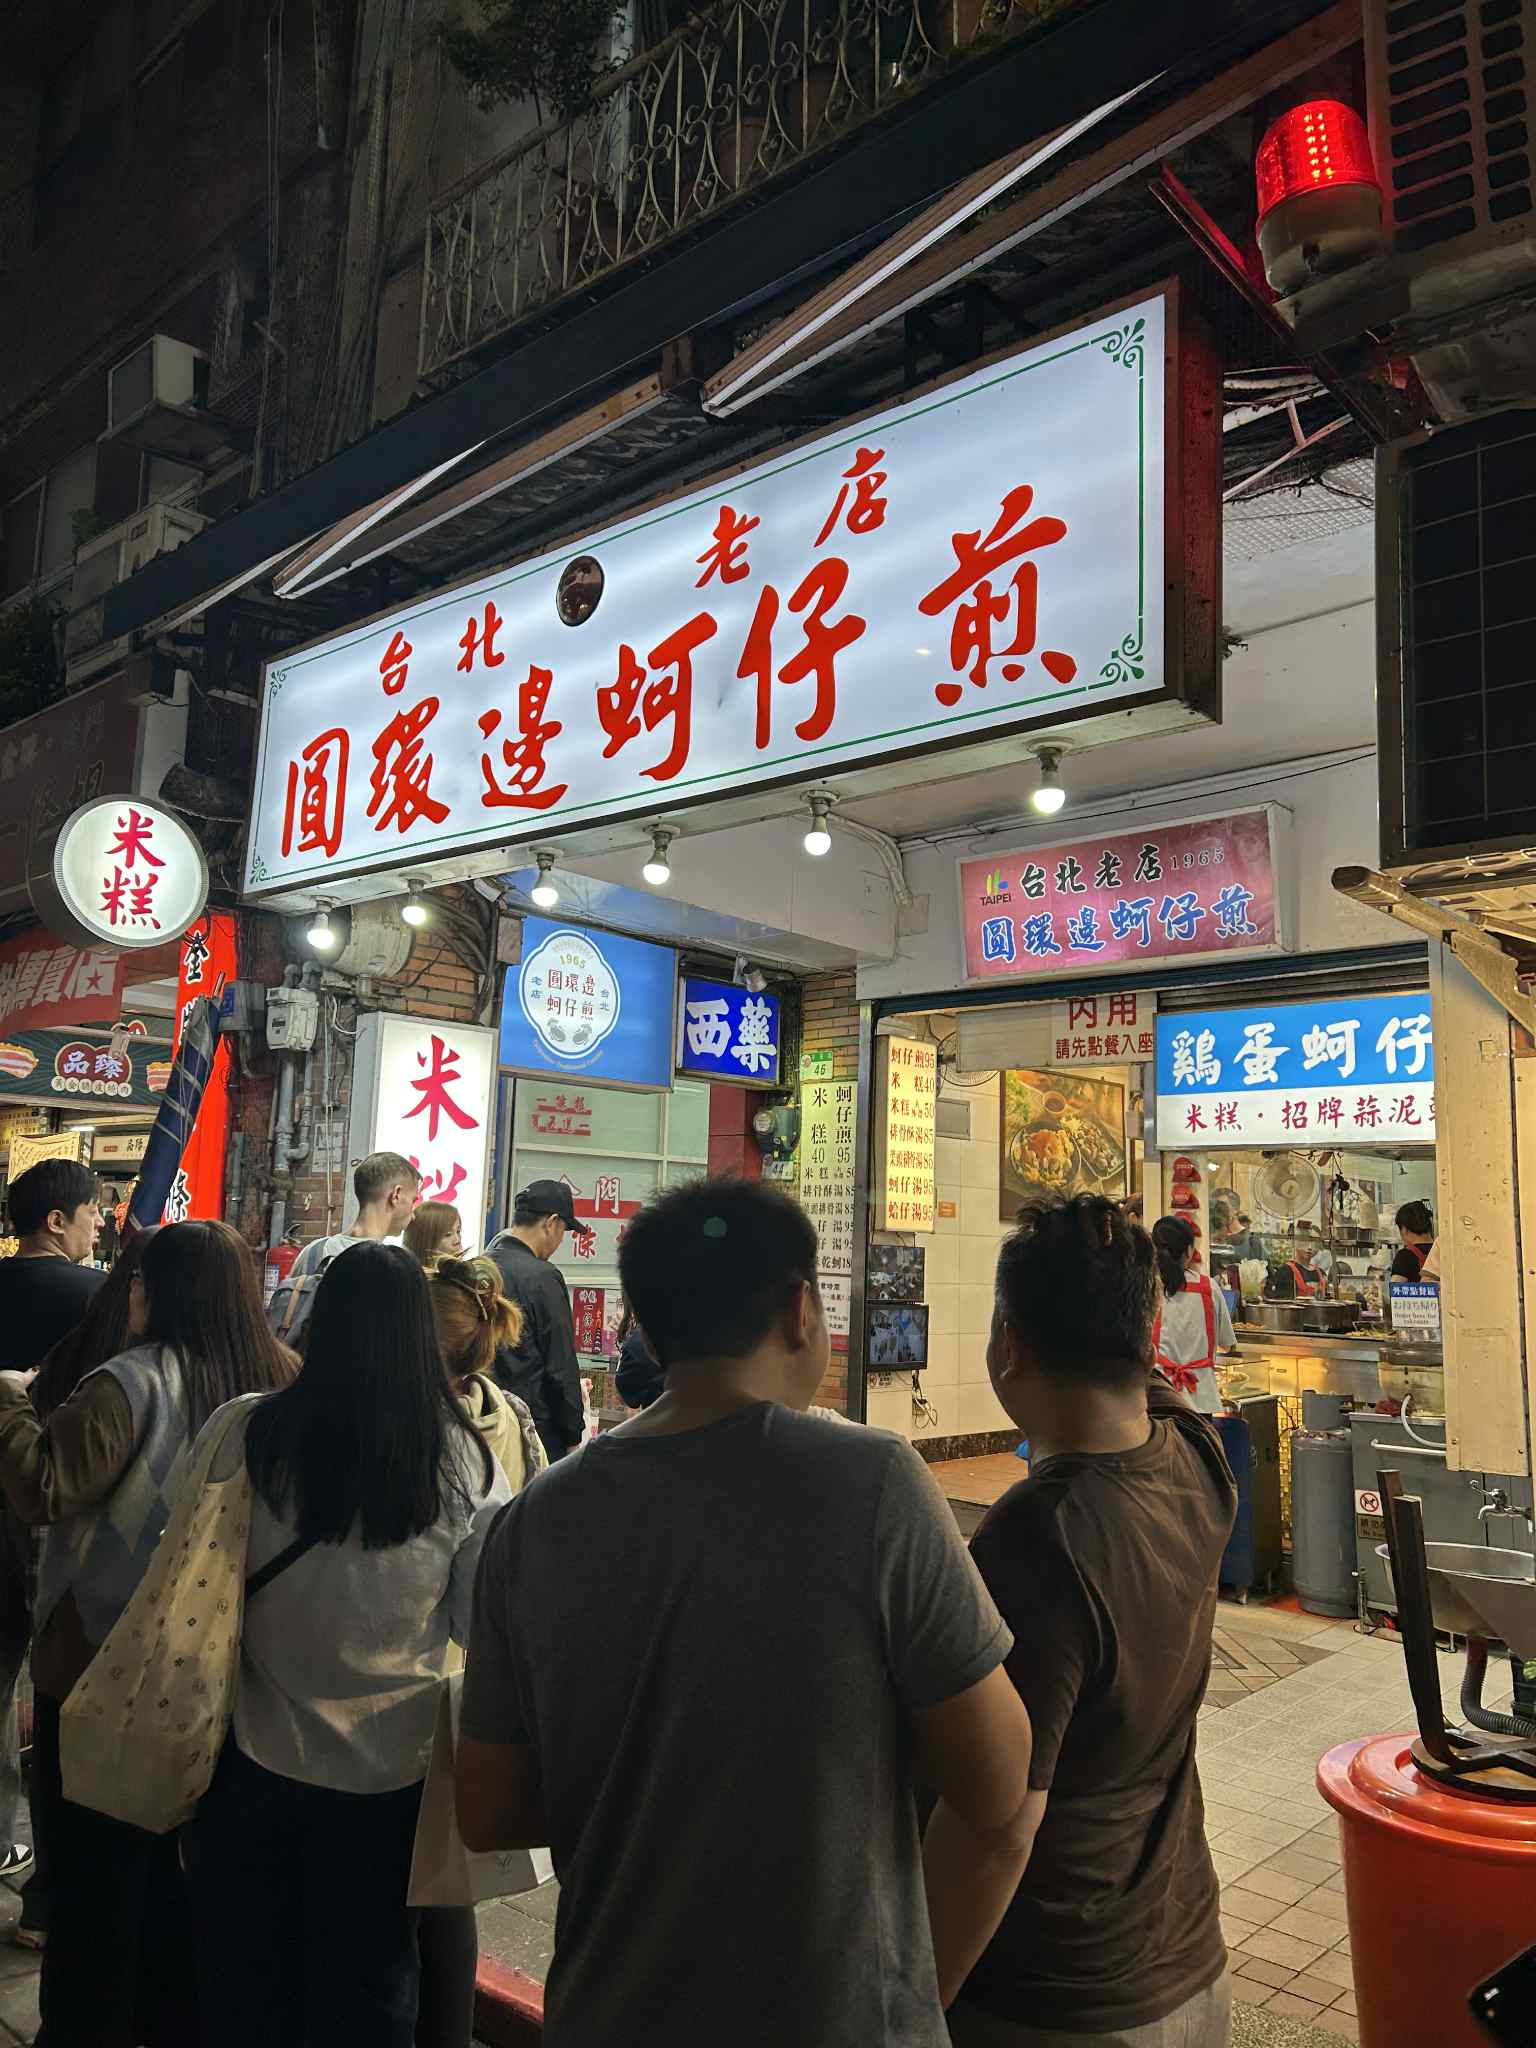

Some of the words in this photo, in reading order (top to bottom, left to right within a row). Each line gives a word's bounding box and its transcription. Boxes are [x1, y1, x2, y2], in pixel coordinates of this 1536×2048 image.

[378, 600, 506, 697] 台北
[694, 447, 889, 588] 老店
[99, 808, 167, 930] 米糕
[1020, 843, 1163, 900] 台北老店
[1169, 847, 1225, 871] 1965
[980, 893, 1011, 906] TAIPEI
[981, 883, 1258, 963] 圓環邊蚵仔煎
[560, 954, 586, 969] 1965
[548, 969, 595, 997] 圓環邊
[547, 995, 594, 1021] 蚵仔煎
[686, 996, 777, 1073] 西藥
[1056, 1031, 1153, 1060] 請先點餐入座
[813, 1064, 826, 1076] 46
[811, 1147, 825, 1163] 40
[837, 1147, 851, 1163] 95
